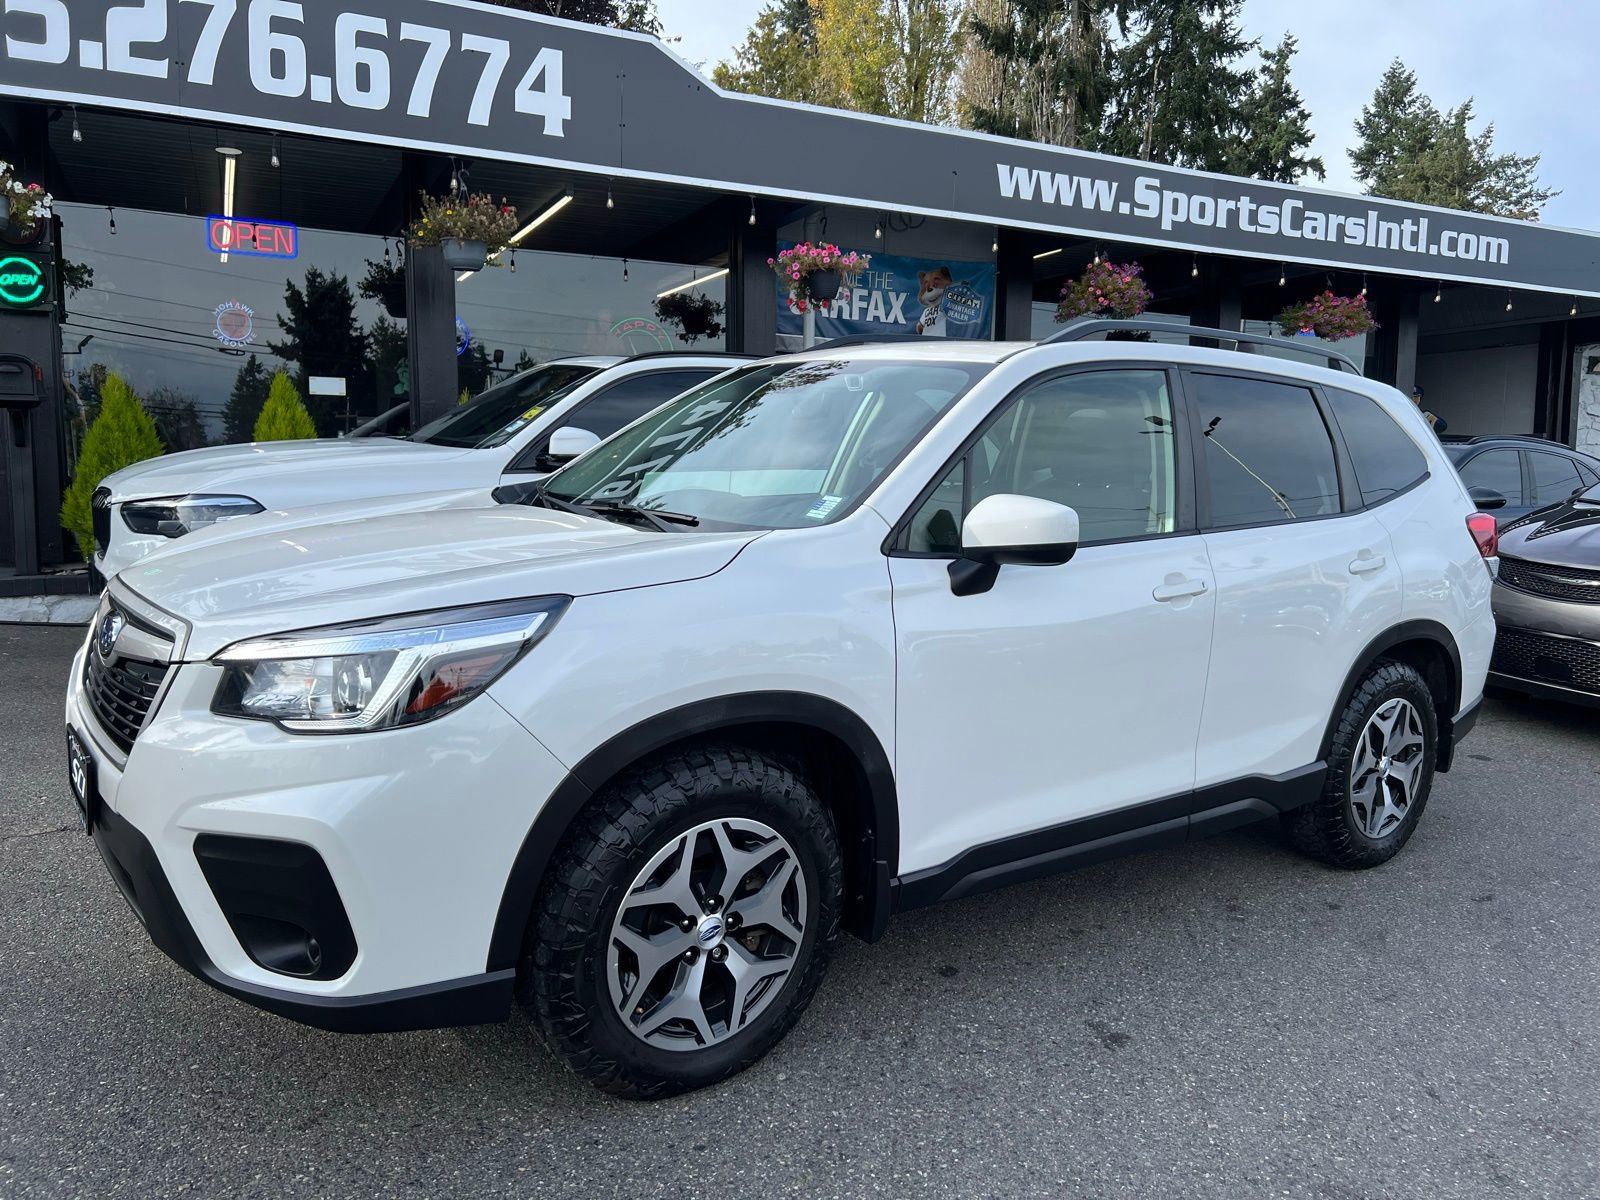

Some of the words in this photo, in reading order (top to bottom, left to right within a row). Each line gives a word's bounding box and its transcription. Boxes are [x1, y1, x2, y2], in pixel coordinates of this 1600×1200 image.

[996, 163, 1509, 265] www.SportsCarsIntl.com
[211, 220, 294, 254] OPEN
[0, 273, 38, 286] OPEN
[866, 270, 894, 290] THE
[211, 301, 255, 317] MOHAWK
[212, 329, 258, 348] GASOLINE
